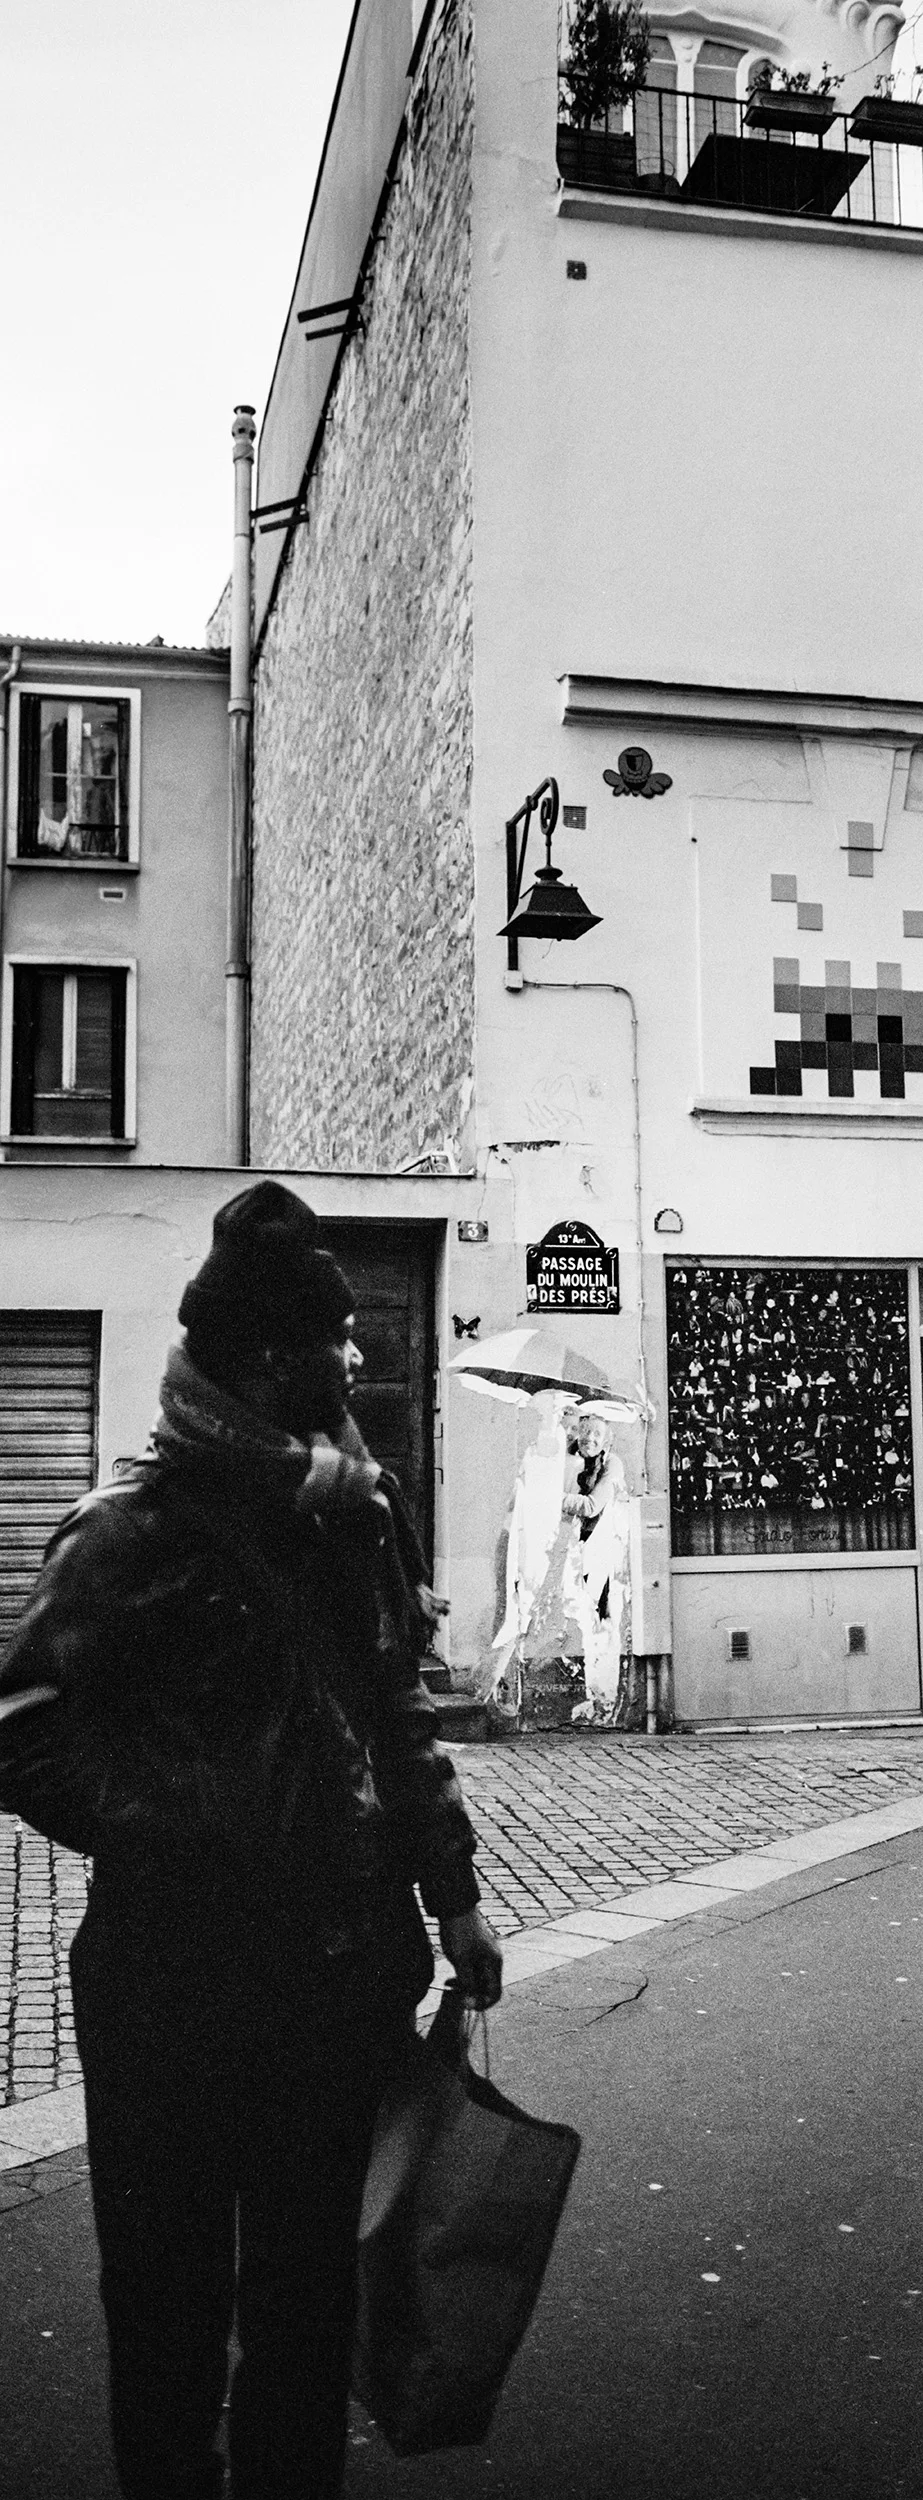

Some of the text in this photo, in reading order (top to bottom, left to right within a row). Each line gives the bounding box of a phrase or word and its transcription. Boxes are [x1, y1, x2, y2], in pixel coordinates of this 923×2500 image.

[467, 1223, 478, 1238] 3
[541, 1257, 602, 1271] PASSAGE
[537, 1273, 608, 1287] DU MOULIN
[540, 1286, 606, 1303] DES PRÉS
